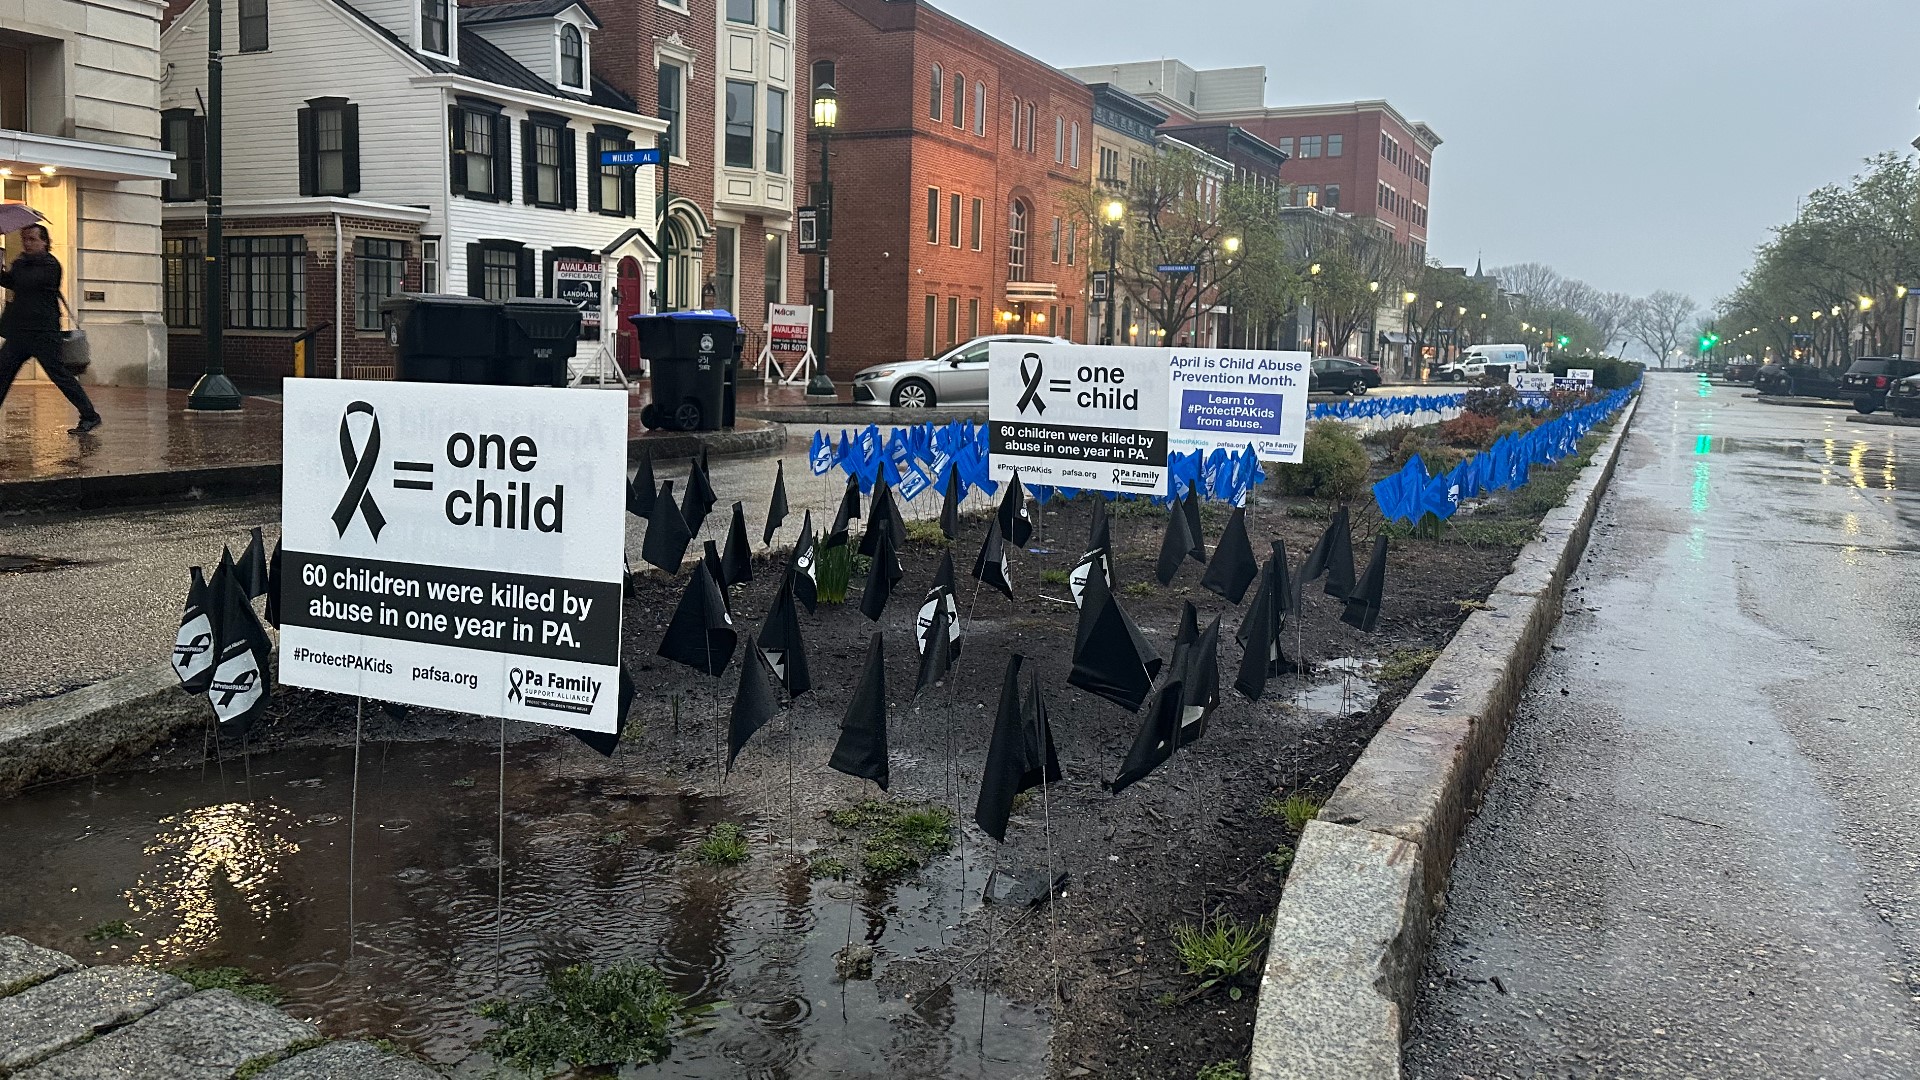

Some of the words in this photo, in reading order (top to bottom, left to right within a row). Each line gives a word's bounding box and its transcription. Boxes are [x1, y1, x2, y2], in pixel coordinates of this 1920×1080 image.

[612, 153, 634, 162] WILLIS
[642, 153, 652, 161] AL
[560, 263, 601, 272] AVAILABLE
[773, 326, 807, 334] AVAILABLE
[1170, 356, 1200, 369] April
[1204, 357, 1215, 368] is
[1219, 357, 1254, 370] Child
[1258, 360, 1302, 372] Abuse
[1077, 365, 1125, 384] one
[1173, 370, 1243, 384] Prevention
[1248, 374, 1296, 387] Month.
[1076, 387, 1138, 410] child
[1208, 394, 1240, 404] Learn
[1244, 396, 1255, 405] to
[1188, 404, 1275, 419] #ProtectPAKids
[1197, 416, 1223, 426] from
[1225, 417, 1262, 429] abuse.
[1000, 425, 1015, 437] 60
[1018, 427, 1065, 440] children
[1068, 432, 1098, 443] were
[1102, 432, 1134, 445] killed
[1138, 435, 1154, 448] by
[1217, 438, 1246, 449] pafsa.org
[446, 432, 538, 472] one
[1005, 440, 1040, 453] abuse
[1044, 442, 1054, 453] in
[1057, 445, 1080, 455] one
[1083, 446, 1110, 457] year
[1113, 447, 1125, 458] in
[1128, 449, 1149, 460] PA.
[1274, 442, 1297, 452] Family
[997, 463, 1052, 475] #ProtectPAKids
[1062, 469, 1097, 479] pafsa.org
[1132, 470, 1159, 483] Family
[445, 479, 564, 533] child
[302, 563, 327, 587] 60
[333, 568, 420, 598] children
[427, 582, 484, 604] were
[491, 582, 555, 612] killed
[562, 590, 593, 621] by
[309, 594, 373, 623] abuse
[380, 602, 398, 626] in
[405, 611, 448, 632] one
[454, 616, 506, 639] year
[513, 617, 534, 643] in
[541, 619, 581, 648] PA.
[294, 647, 393, 674] #ProtectPAKids
[412, 666, 478, 689] pafsa.org
[525, 669, 542, 687] Pa
[548, 672, 601, 703] Family
[525, 688, 554, 698] SUPPORT
[557, 692, 590, 702] ALLIANCE
